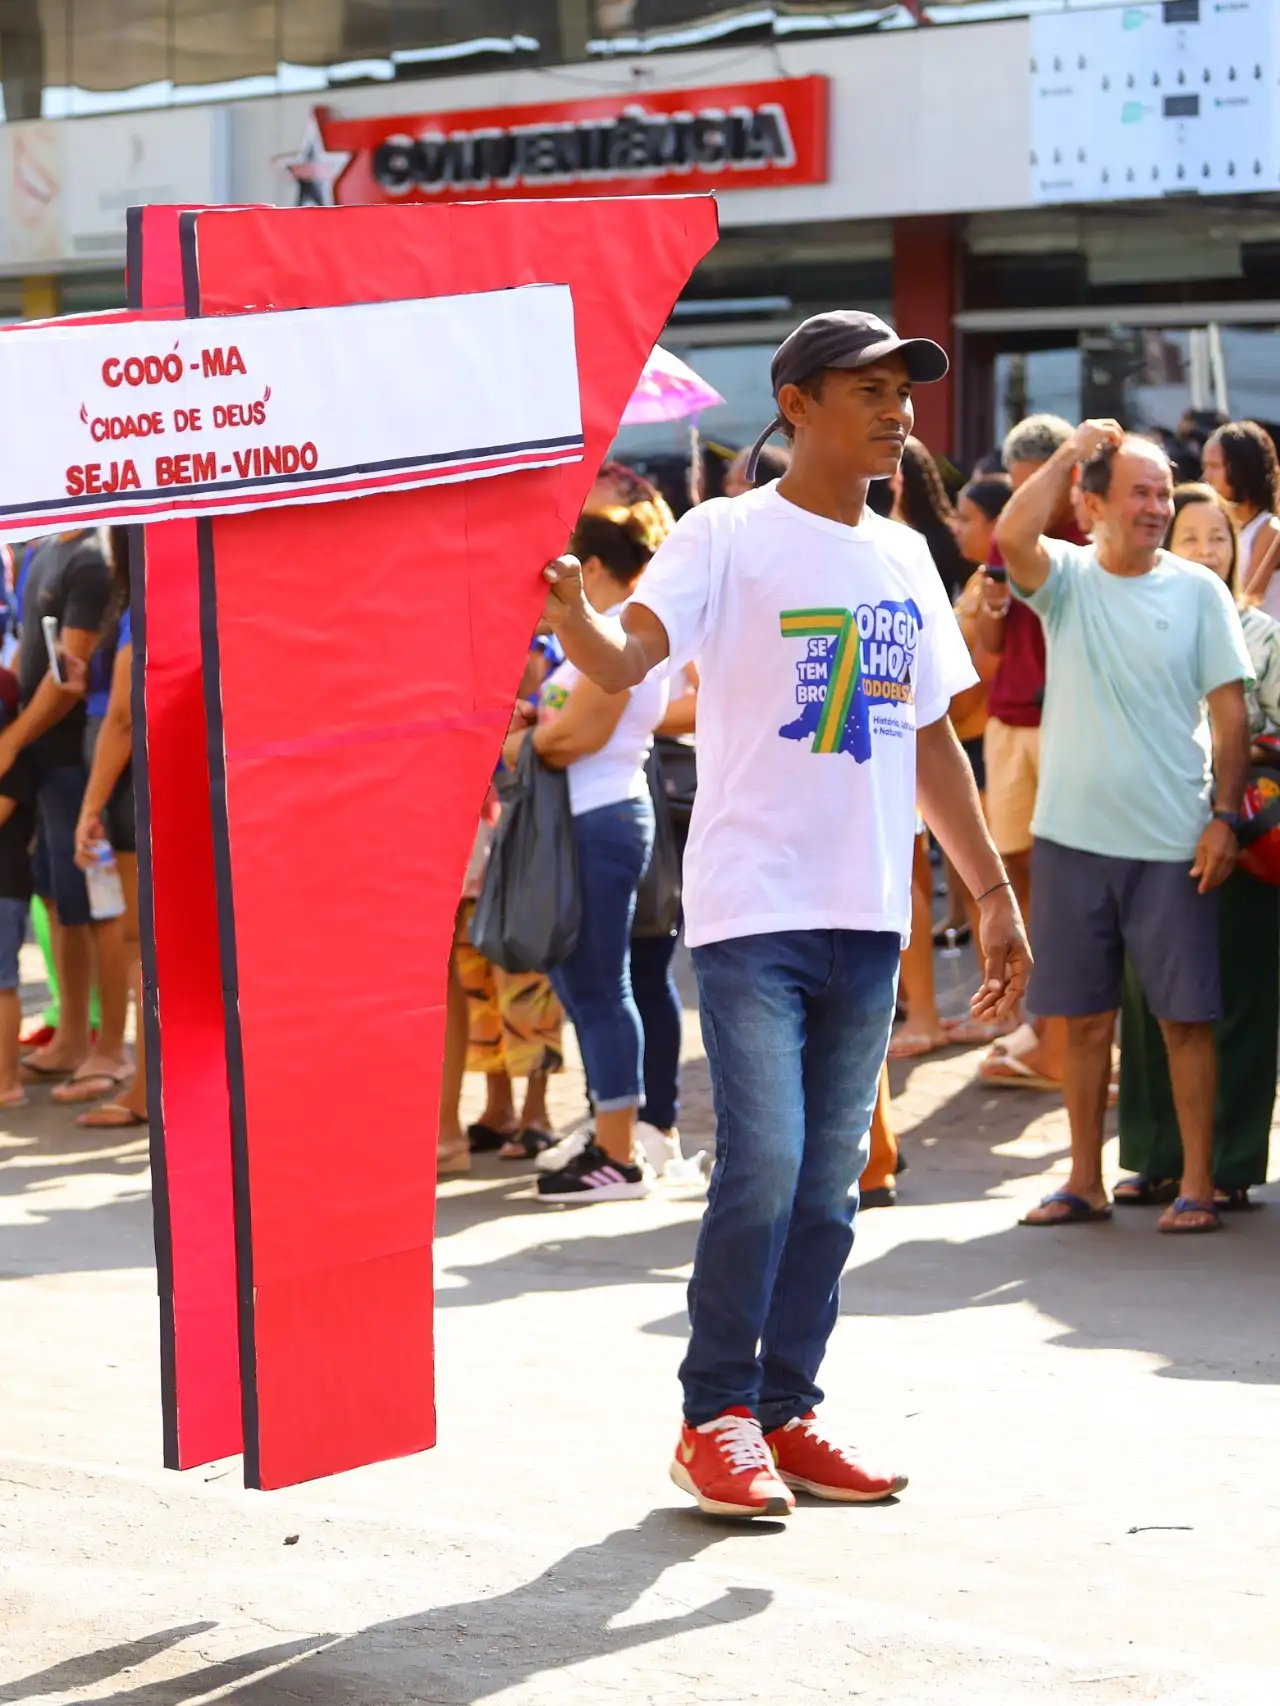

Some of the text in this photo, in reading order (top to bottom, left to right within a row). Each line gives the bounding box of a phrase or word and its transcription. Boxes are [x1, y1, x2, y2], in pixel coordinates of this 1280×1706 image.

[174, 408, 202, 432] DE
[65, 441, 318, 496] SEJA BEM-VINDO
[808, 638, 827, 657] SE
[796, 661, 827, 681] TEM
[796, 685, 828, 704] BRO
